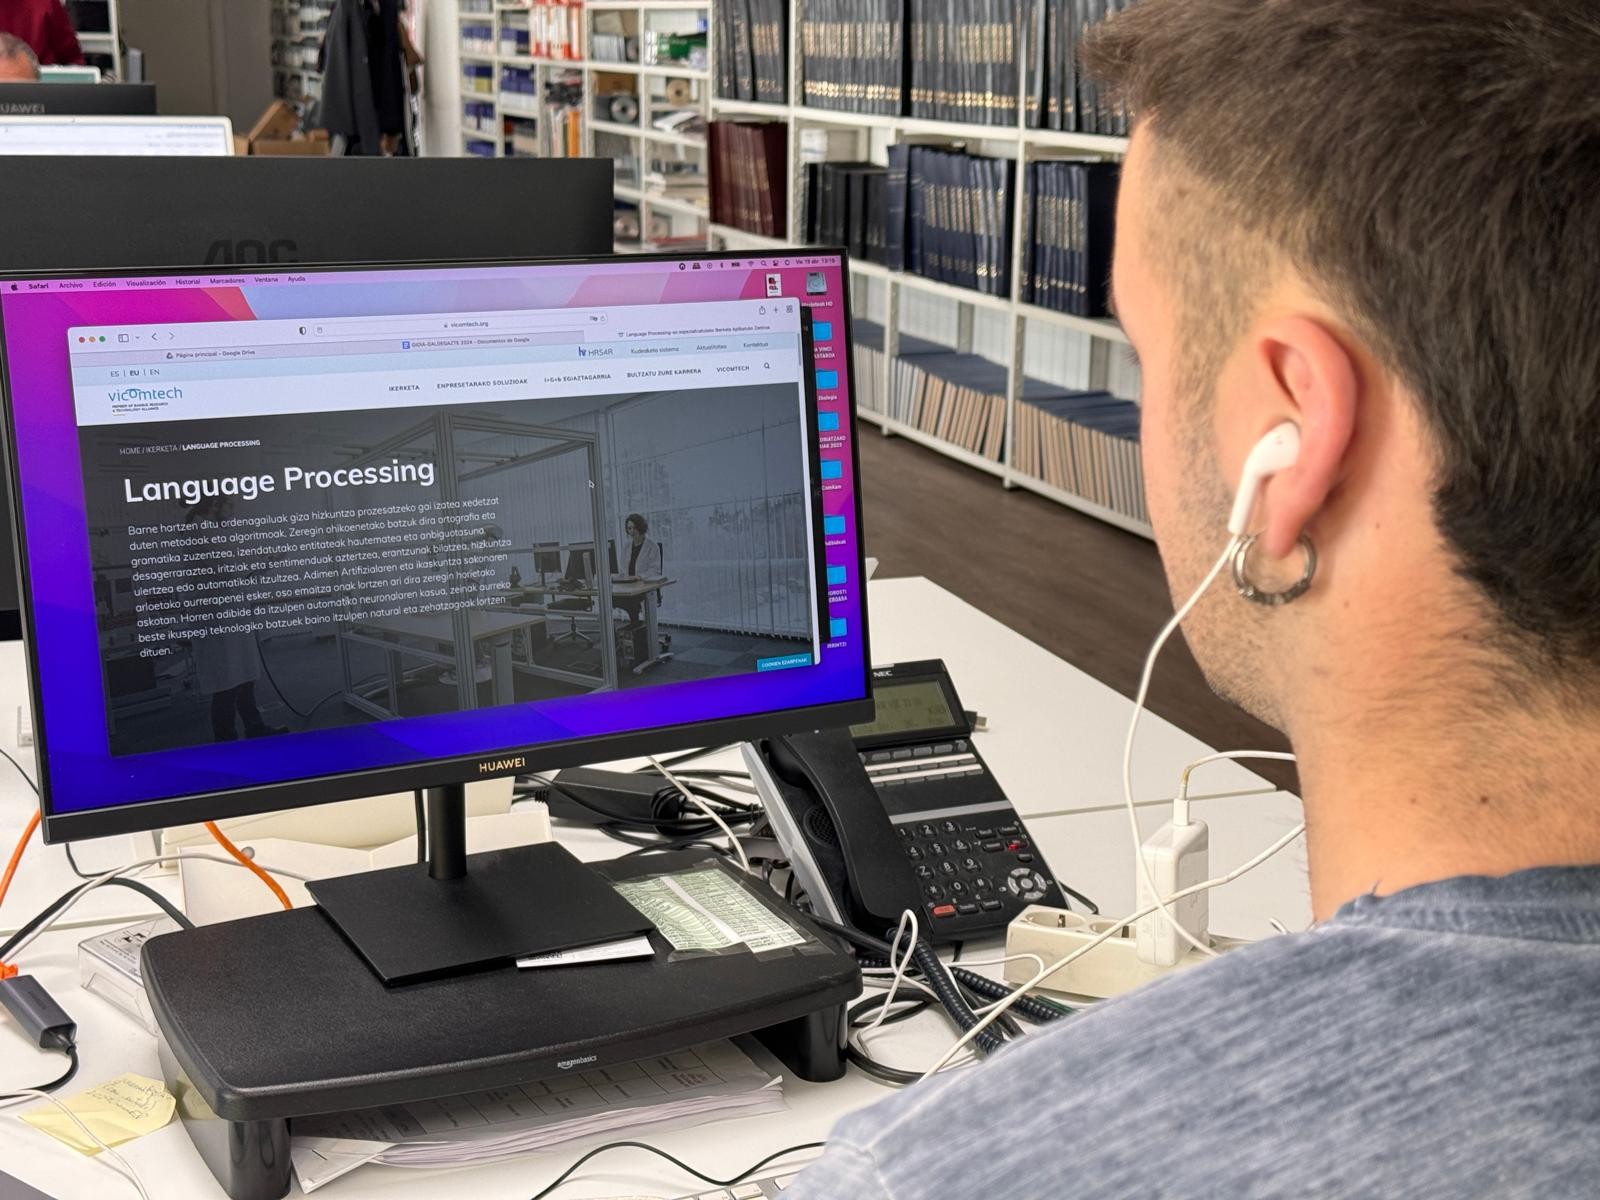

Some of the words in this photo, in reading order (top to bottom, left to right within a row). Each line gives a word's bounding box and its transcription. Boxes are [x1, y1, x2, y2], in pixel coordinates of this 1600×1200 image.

[0, 103, 45, 113] UAWEI
[28, 282, 49, 290] Safari
[125, 279, 167, 287] Visualización
[287, 275, 307, 283] Ayuda
[450, 320, 489, 328] vicomtech.org
[111, 370, 120, 378] ES
[149, 368, 160, 376] EN
[627, 370, 657, 378] BULTZATU
[658, 369, 673, 377] ZURE
[716, 365, 750, 373] VICOMTECH
[388, 384, 420, 392] IKERKETA
[437, 380, 491, 389] ENPRESETARAKO
[492, 378, 528, 387] SOLUZIOAK
[108, 386, 183, 402] vicomtech
[120, 447, 141, 455] HOME
[182, 441, 219, 451] LANGUAGE
[219, 439, 261, 448] PROCESSING
[124, 474, 275, 505] Language
[284, 458, 435, 491] Processing
[128, 525, 158, 535] Barne
[160, 522, 198, 533] hartzen
[200, 520, 219, 530] ditu
[221, 513, 288, 528] ordenagailuak
[290, 513, 310, 524] giza
[311, 509, 355, 520] hizkuntza
[357, 503, 416, 518] prozesatzeko
[418, 501, 432, 514] gai
[433, 500, 460, 510] izatea
[462, 497, 500, 507] xedetzat
[129, 541, 158, 551] duten
[160, 536, 210, 549] metodoak
[211, 535, 227, 544] eta
[229, 529, 287, 544] algoritmoak.
[289, 526, 324, 538] Zeregin
[326, 521, 385, 533] ohikoenetako
[387, 517, 418, 529] batzuk
[419, 516, 436, 526] dira
[438, 513, 480, 525] ortografia
[481, 511, 496, 520] eta
[131, 554, 181, 569] gramatika
[183, 549, 235, 561] zuzentzea,
[237, 543, 298, 557] izendatutako
[300, 538, 346, 551] entitateak
[347, 533, 402, 546] hautematea
[403, 532, 418, 541] eta
[420, 526, 485, 541] anbiguotasuna
[132, 566, 216, 581] desagerraraztea,
[217, 562, 249, 573] iritziak
[250, 562, 267, 570] eta
[268, 554, 333, 569] sentimenduak
[335, 551, 380, 562] aztertzea,
[382, 547, 432, 558] erantzunak,
[433, 542, 470, 553] bilatzea,
[471, 538, 512, 549] hizkuntza
[134, 586, 174, 597] ulertzea
[176, 583, 195, 592] edo
[196, 577, 258, 590] automatikoki
[260, 574, 301, 585] itzultzea.
[303, 569, 339, 580] Adimen
[341, 564, 398, 576] Artifizialaren
[400, 562, 414, 570] eta
[416, 558, 462, 569] ikaskuntza
[463, 553, 508, 564] sakonaren
[135, 601, 181, 612] arloetako
[183, 593, 244, 608] aurrerapenei
[246, 590, 274, 601] esker,
[275, 588, 293, 597] oso
[294, 585, 332, 596] emaitza
[333, 580, 356, 591] onak
[357, 579, 389, 590] lortzen
[390, 577, 402, 586] ari
[403, 574, 421, 584] dira
[422, 571, 454, 583] zeregin
[456, 568, 496, 579] horietako
[137, 616, 179, 627] askotan.
[180, 612, 214, 623] Horren
[216, 607, 252, 619] adibide
[253, 606, 266, 615] da
[268, 602, 305, 614] itzulpen
[306, 596, 358, 610] automatiko
[359, 590, 418, 604] neuronalaren
[419, 588, 448, 598] kasua,
[449, 585, 478, 595] zeinak
[479, 580, 512, 591] aurreko
[138, 632, 166, 643] beste
[168, 629, 208, 640] ikuspegi
[210, 621, 264, 635] teknologiko
[265, 617, 303, 630] batzuek
[304, 614, 331, 625] baino
[333, 611, 368, 622] itzulpen
[370, 605, 401, 617] natural
[403, 606, 418, 614] eta
[420, 599, 475, 613] zehatzagoak
[476, 596, 506, 607] lortzen
[140, 647, 174, 658] dituen.
[873, 670, 893, 678] NEC
[479, 757, 526, 773] HUAWEI
[953, 882, 961, 890] 0
[557, 1055, 597, 1069] amazonbasics
